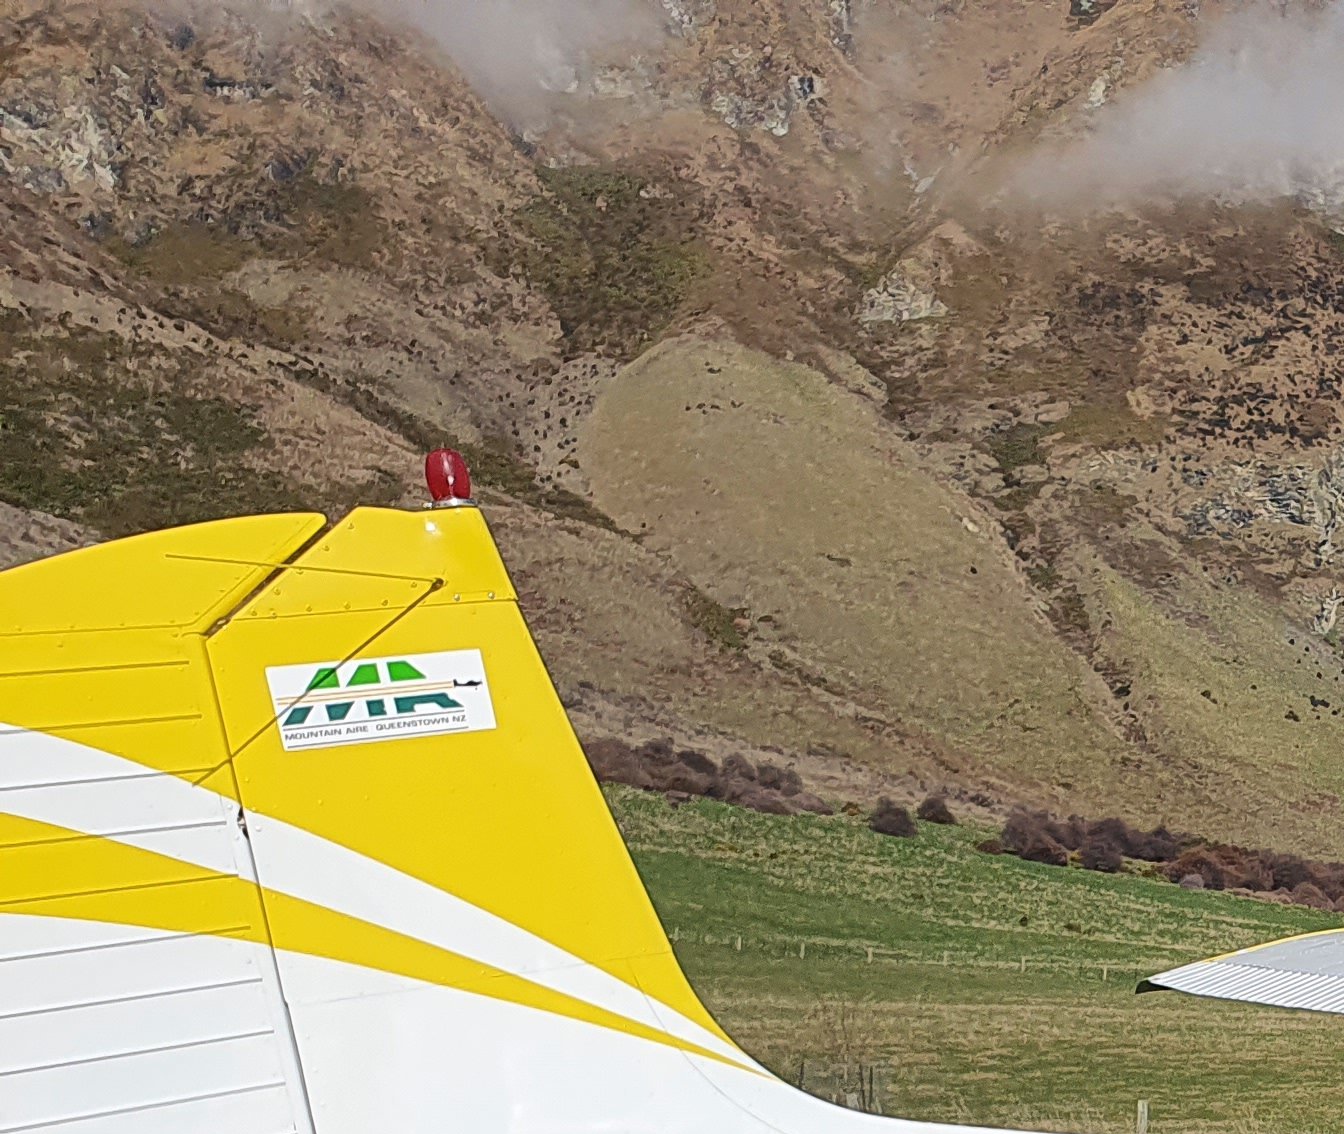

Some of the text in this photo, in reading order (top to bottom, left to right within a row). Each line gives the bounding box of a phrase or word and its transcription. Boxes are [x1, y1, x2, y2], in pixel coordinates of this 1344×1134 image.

[284, 714, 468, 741] MOUNTAIN AIRE QUEENSTOWN NZ
